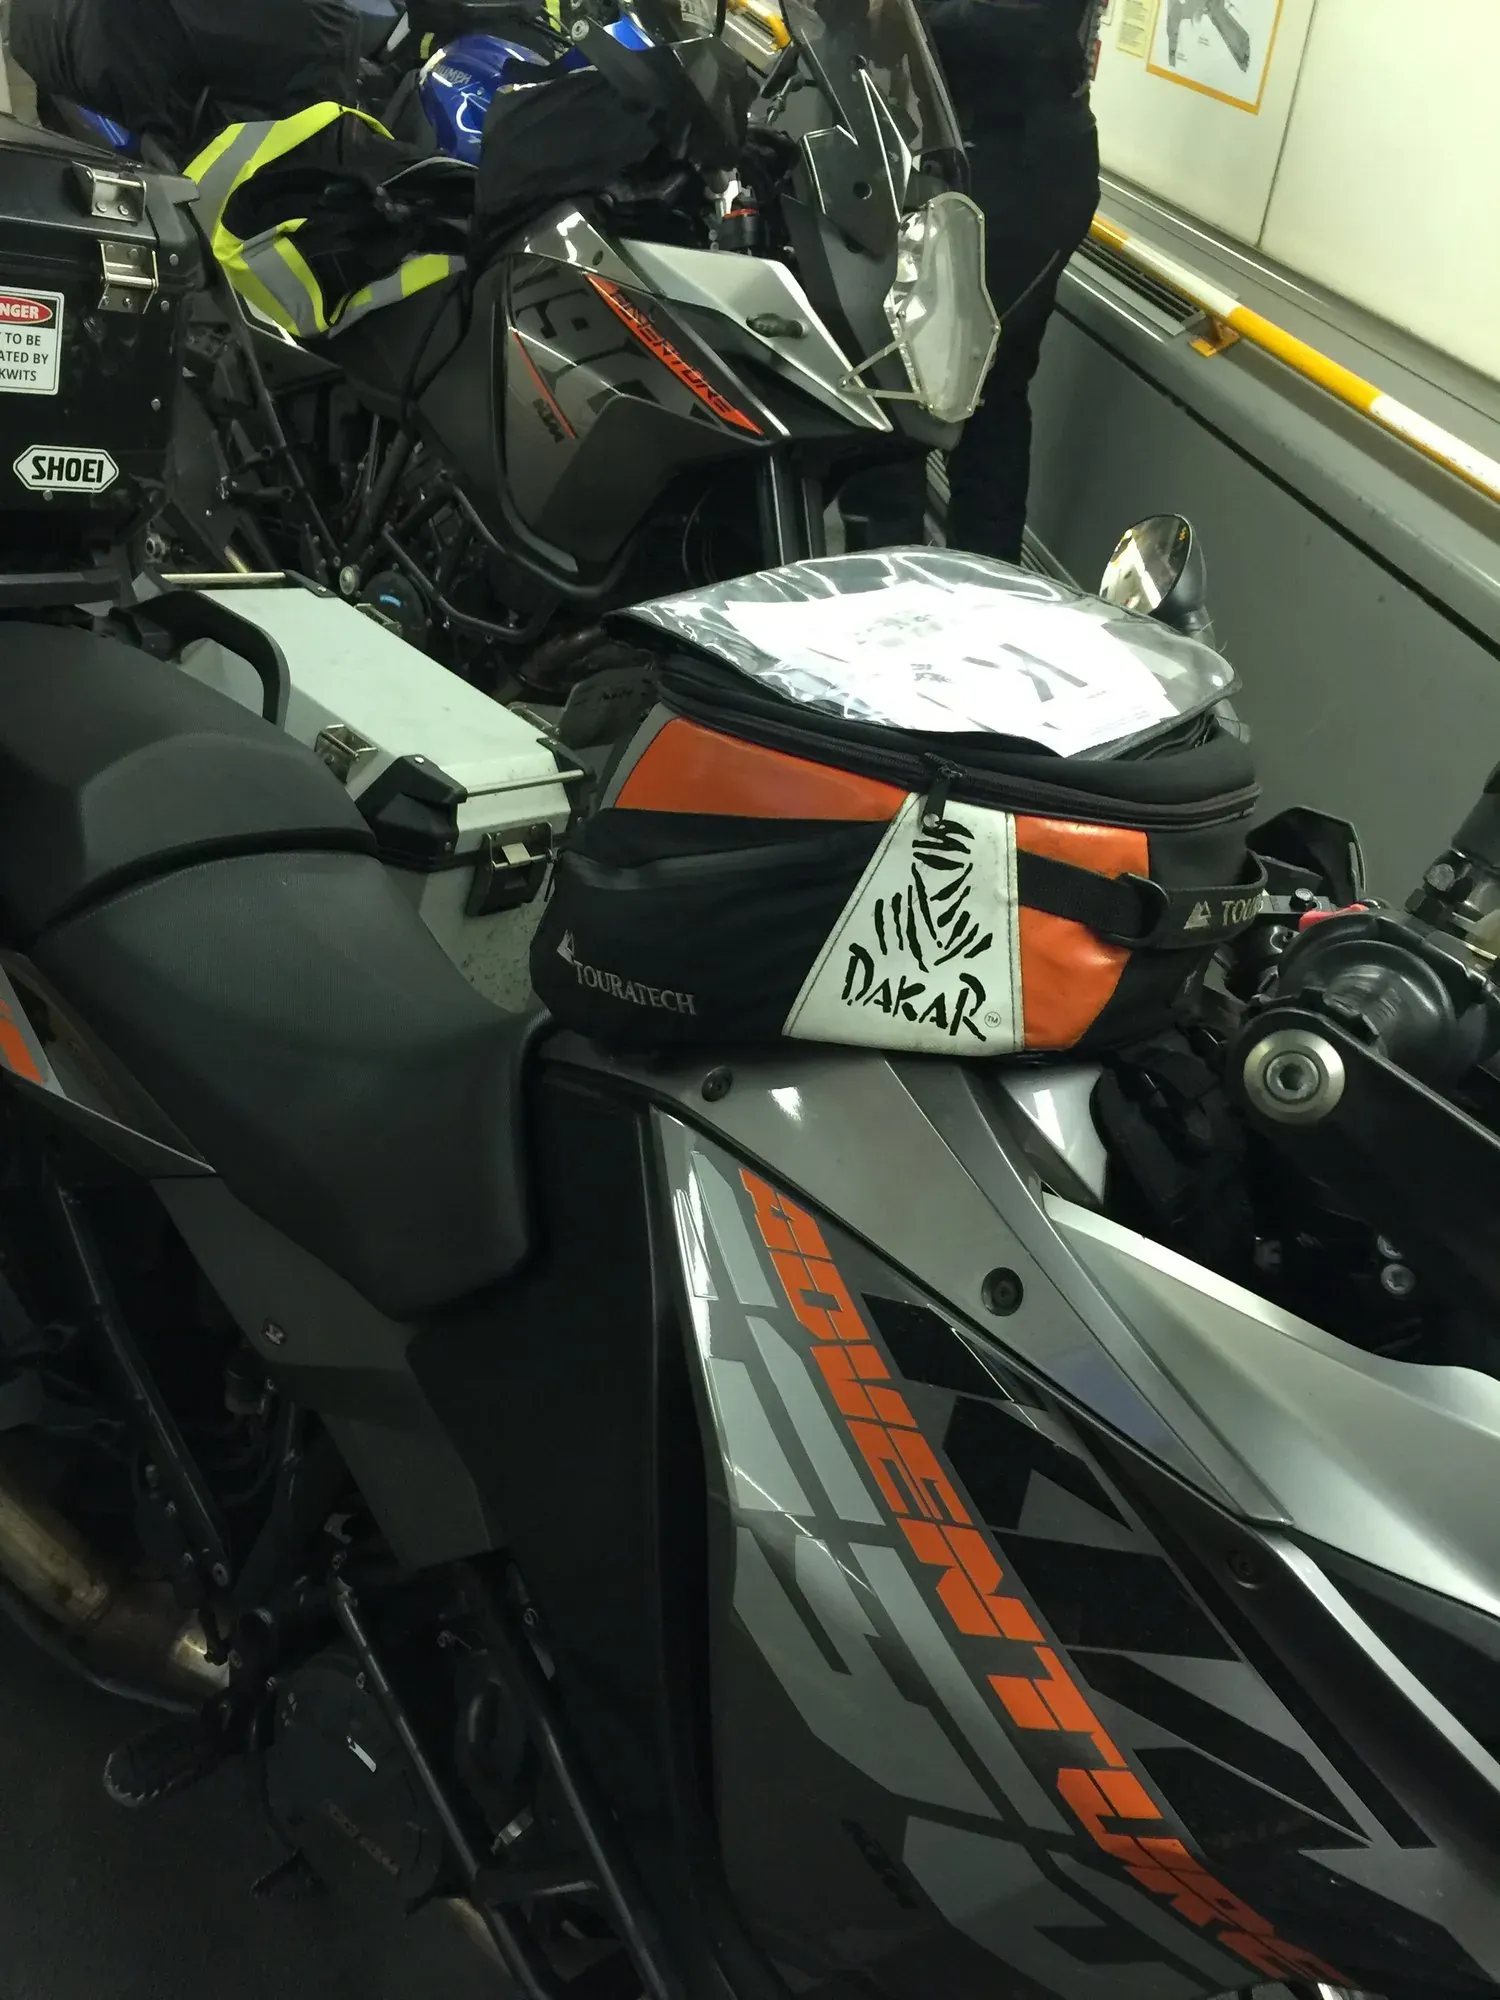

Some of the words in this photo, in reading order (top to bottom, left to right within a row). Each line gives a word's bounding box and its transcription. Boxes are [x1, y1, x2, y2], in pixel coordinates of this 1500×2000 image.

[0, 302, 39, 319] NGER
[5, 331, 22, 344] TO
[26, 334, 41, 346] BE
[33, 353, 49, 365] BY
[31, 455, 105, 484] SHOEI
[573, 959, 697, 1016] TOURATECH
[841, 942, 988, 1042] DAKAR
[738, 1167, 1358, 1988] ADVENTURE
